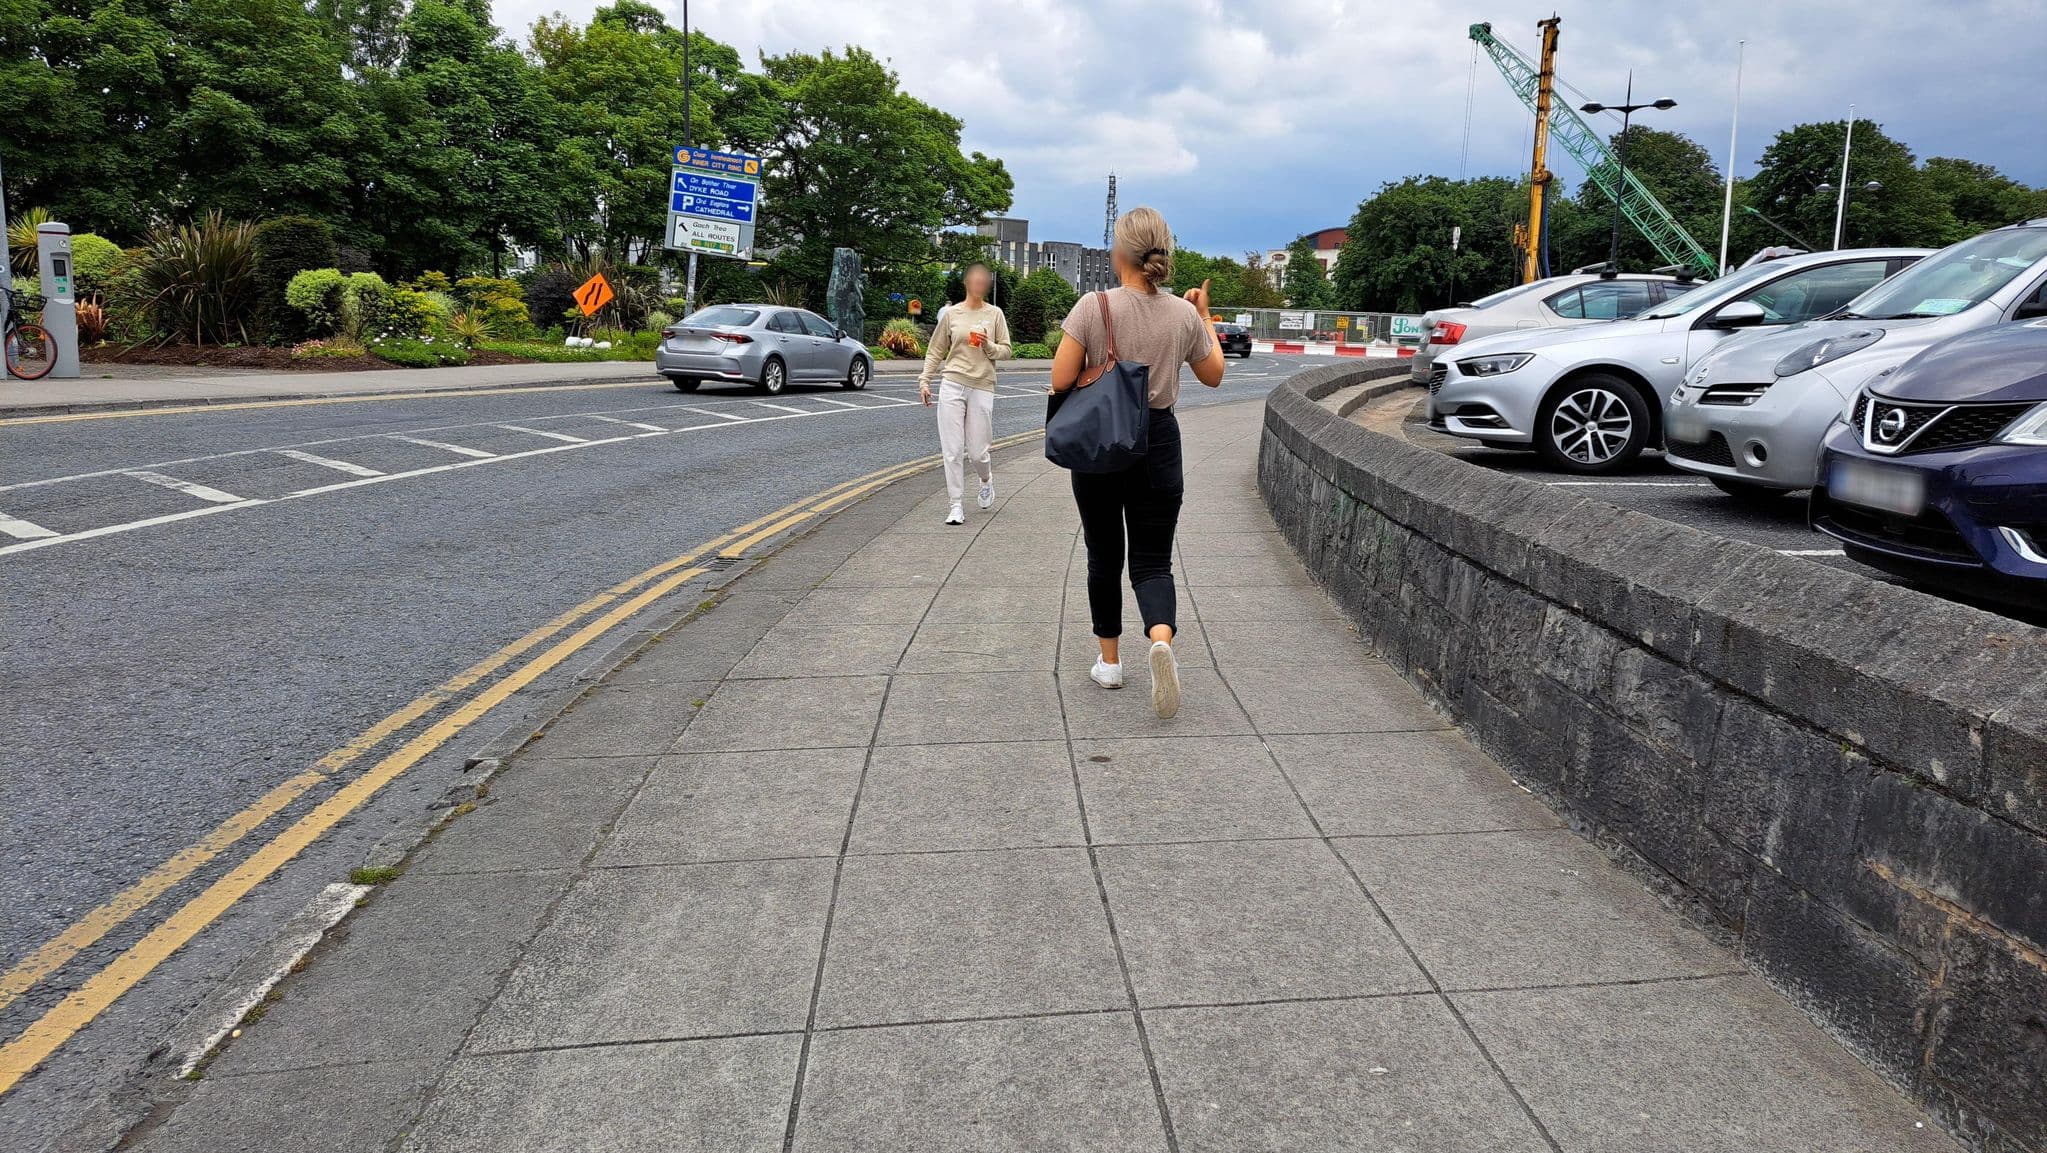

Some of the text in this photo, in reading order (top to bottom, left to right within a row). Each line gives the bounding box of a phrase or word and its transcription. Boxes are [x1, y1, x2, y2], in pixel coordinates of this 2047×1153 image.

[682, 196, 694, 210] P
[695, 206, 734, 217] CATHEDRAL
[708, 233, 735, 242] ROUTES
